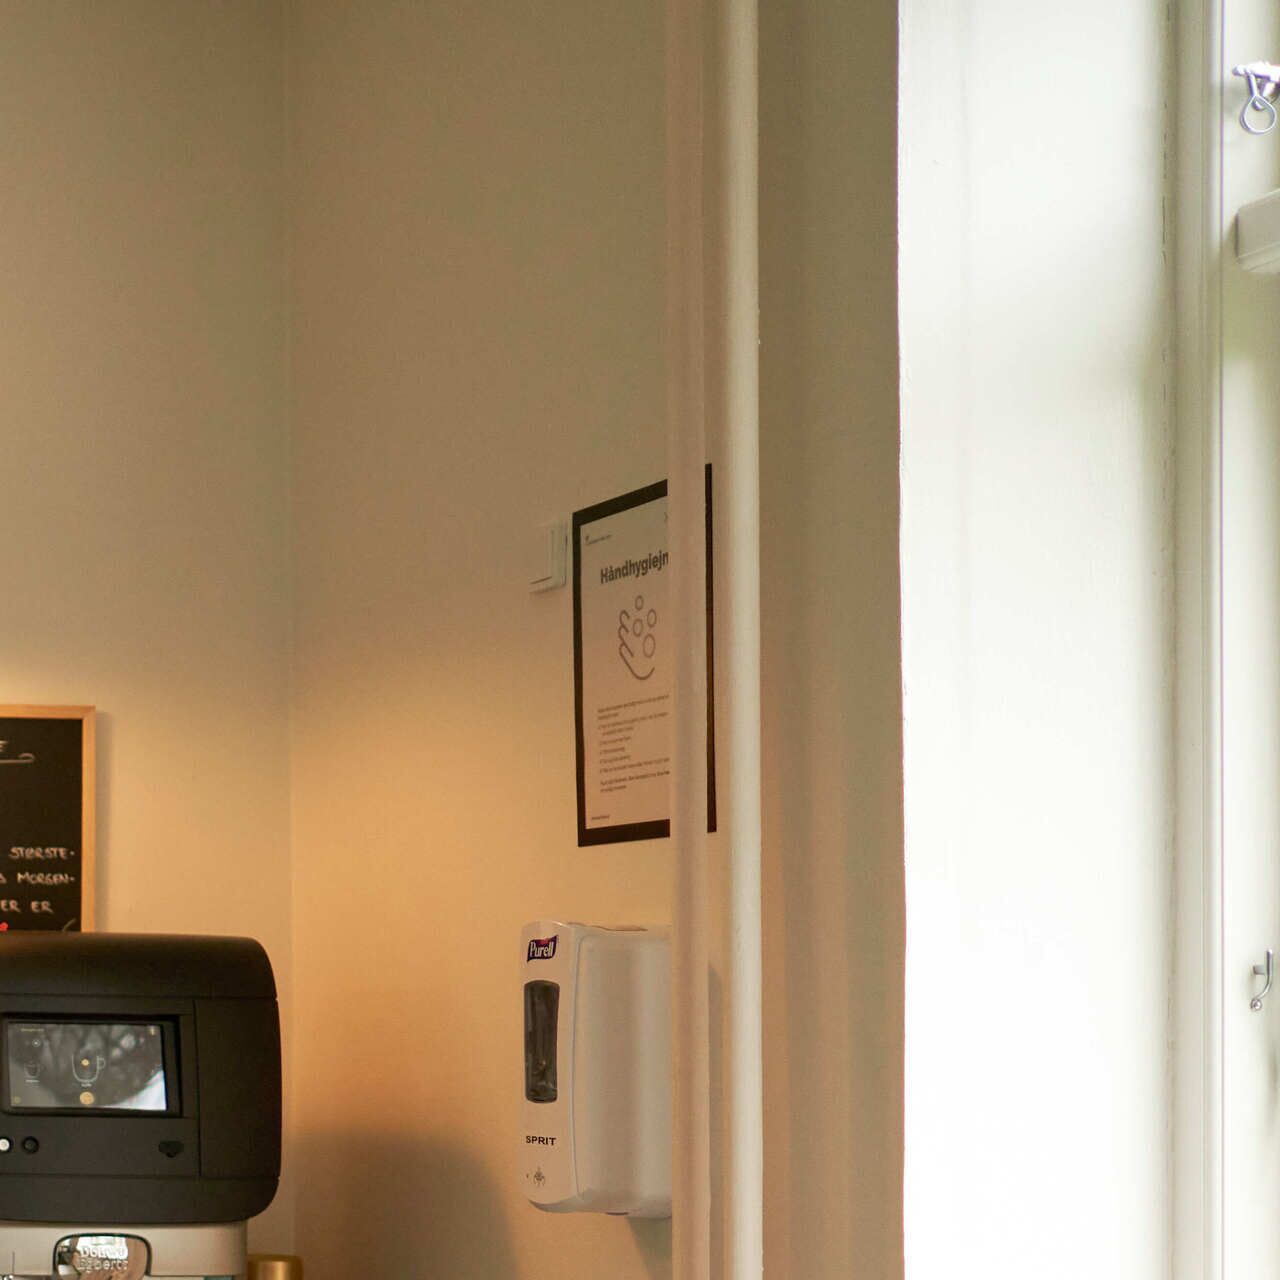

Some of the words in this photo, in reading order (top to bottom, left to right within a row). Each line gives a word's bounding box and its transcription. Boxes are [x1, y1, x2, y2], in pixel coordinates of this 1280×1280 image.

[600, 549, 669, 584] Håndhygiejn
[31, 900, 54, 914] ER
[529, 941, 554, 957] Purell
[525, 1135, 557, 1146] SPRIT
